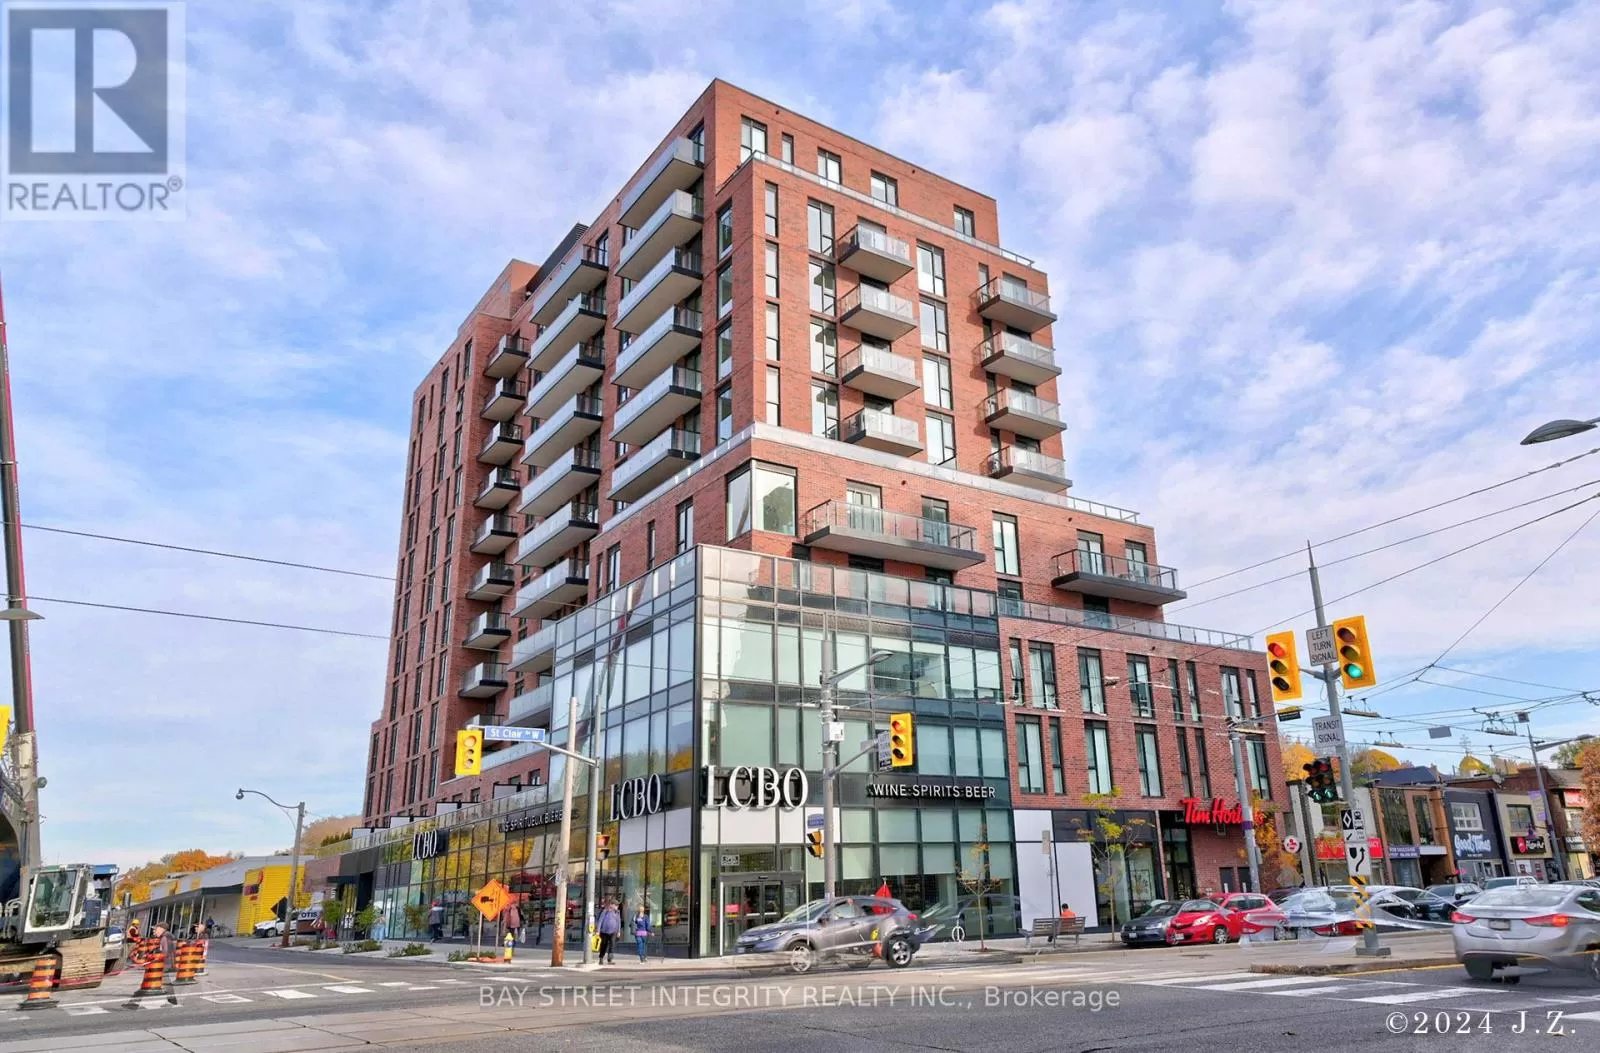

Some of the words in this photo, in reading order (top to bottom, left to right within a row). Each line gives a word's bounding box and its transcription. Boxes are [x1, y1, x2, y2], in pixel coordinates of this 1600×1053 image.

[1312, 629, 1329, 640] LEFT
[1313, 642, 1332, 652] TURN
[1311, 651, 1337, 663] SIGNAL
[1315, 720, 1340, 731] TRANSIT
[503, 729, 522, 739] Clair
[1318, 732, 1341, 743] SIGNAL
[703, 764, 809, 810] LCBO
[873, 784, 907, 797] WINE
[912, 784, 961, 798] SPIRITS
[965, 785, 996, 798] BEER
[609, 772, 661, 822] LCBO
[1183, 797, 1211, 824] Tim
[412, 829, 438, 861] LCBO
[301, 911, 318, 919] OTIS
